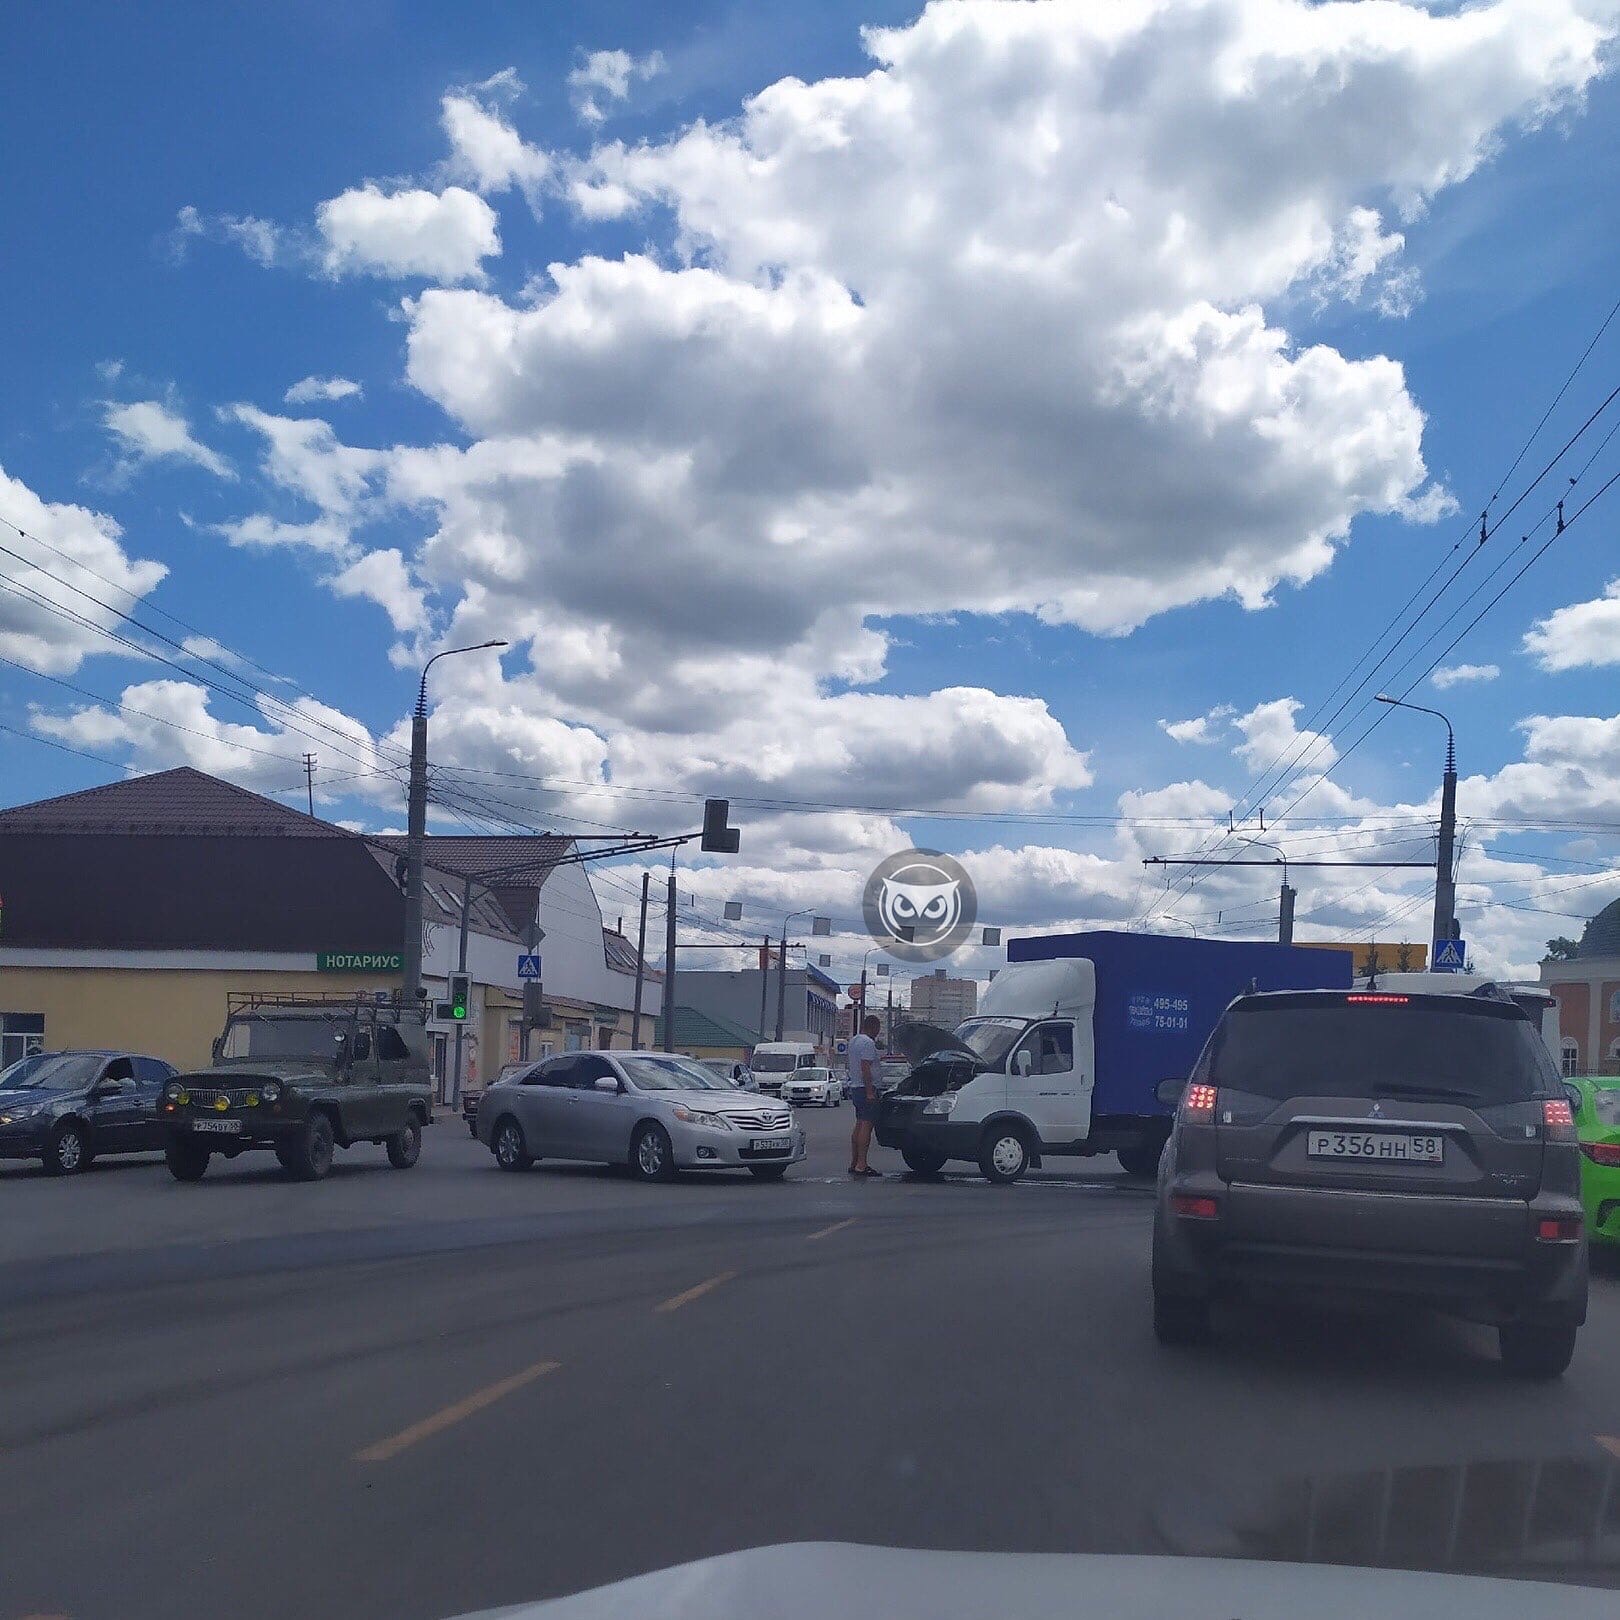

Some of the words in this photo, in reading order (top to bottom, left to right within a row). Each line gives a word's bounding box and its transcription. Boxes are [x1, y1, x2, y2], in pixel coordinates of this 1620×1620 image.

[326, 955, 400, 968] НОТАРИУС
[1153, 997, 1188, 1011] 495-495
[1155, 1015, 1188, 1029] 75-01-01
